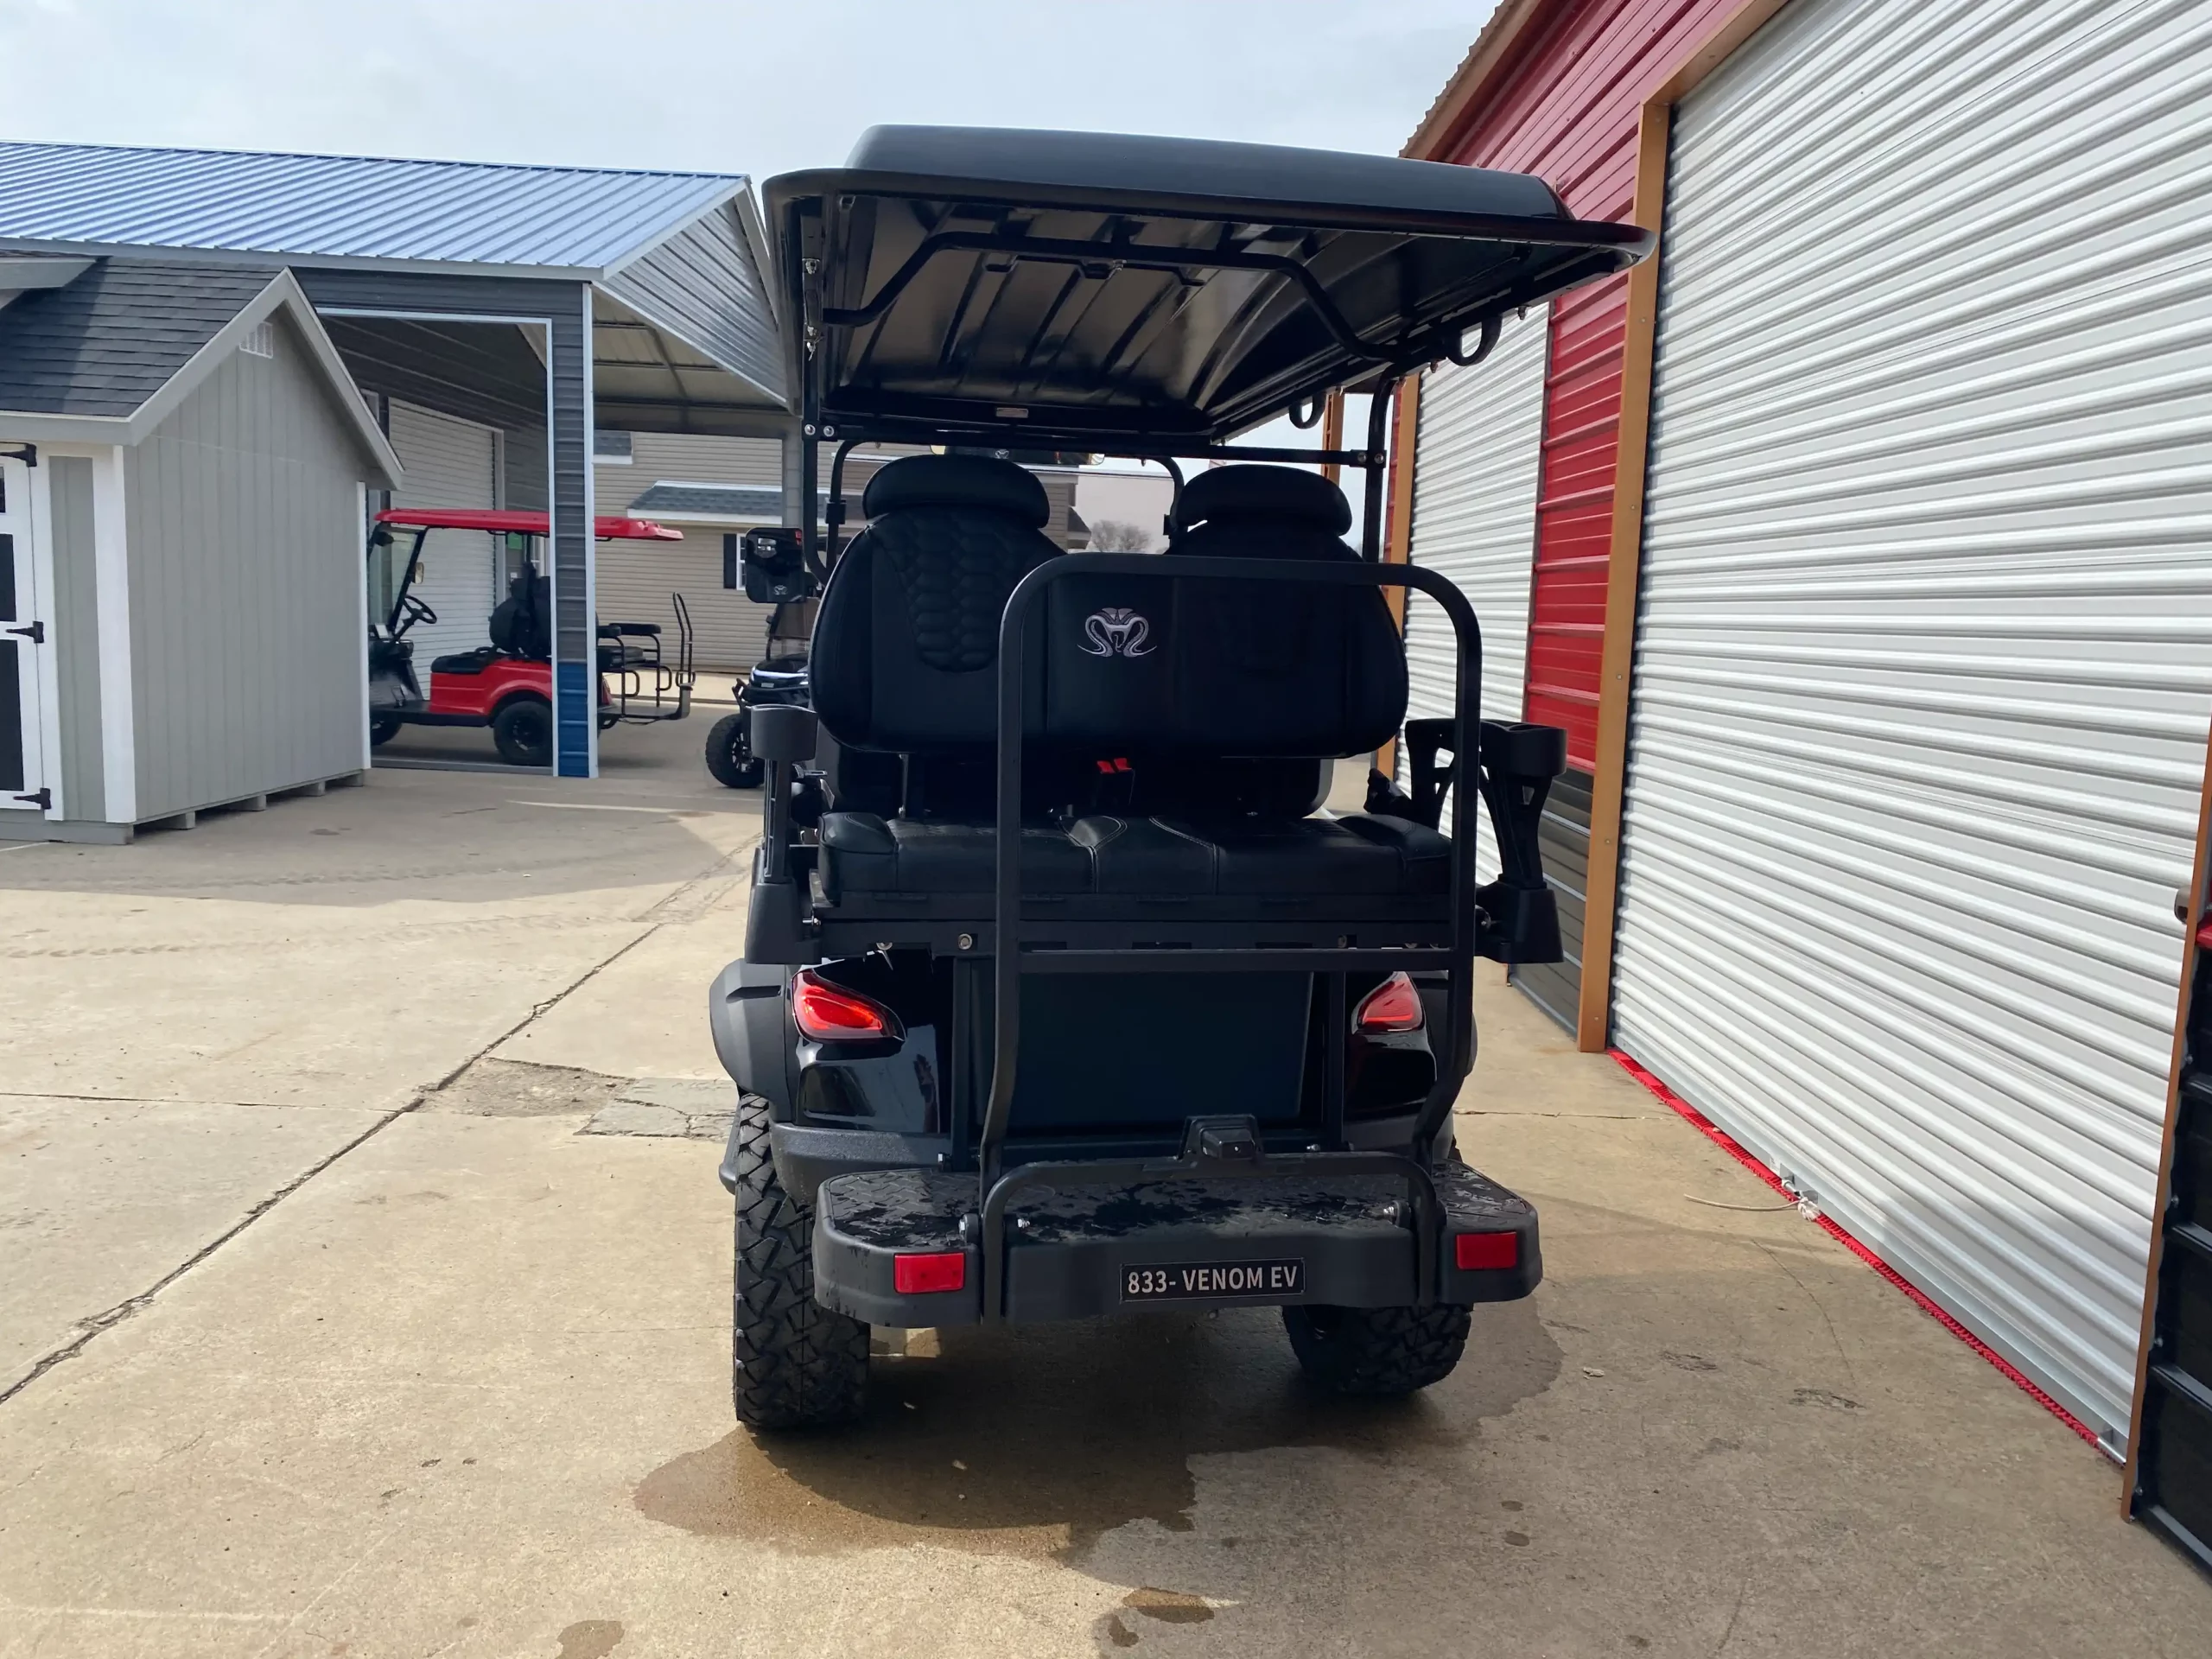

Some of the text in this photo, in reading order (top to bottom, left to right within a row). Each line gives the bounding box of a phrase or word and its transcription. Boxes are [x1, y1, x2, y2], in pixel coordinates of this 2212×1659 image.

[1128, 1266, 1298, 1294] 833- VENOM EV
